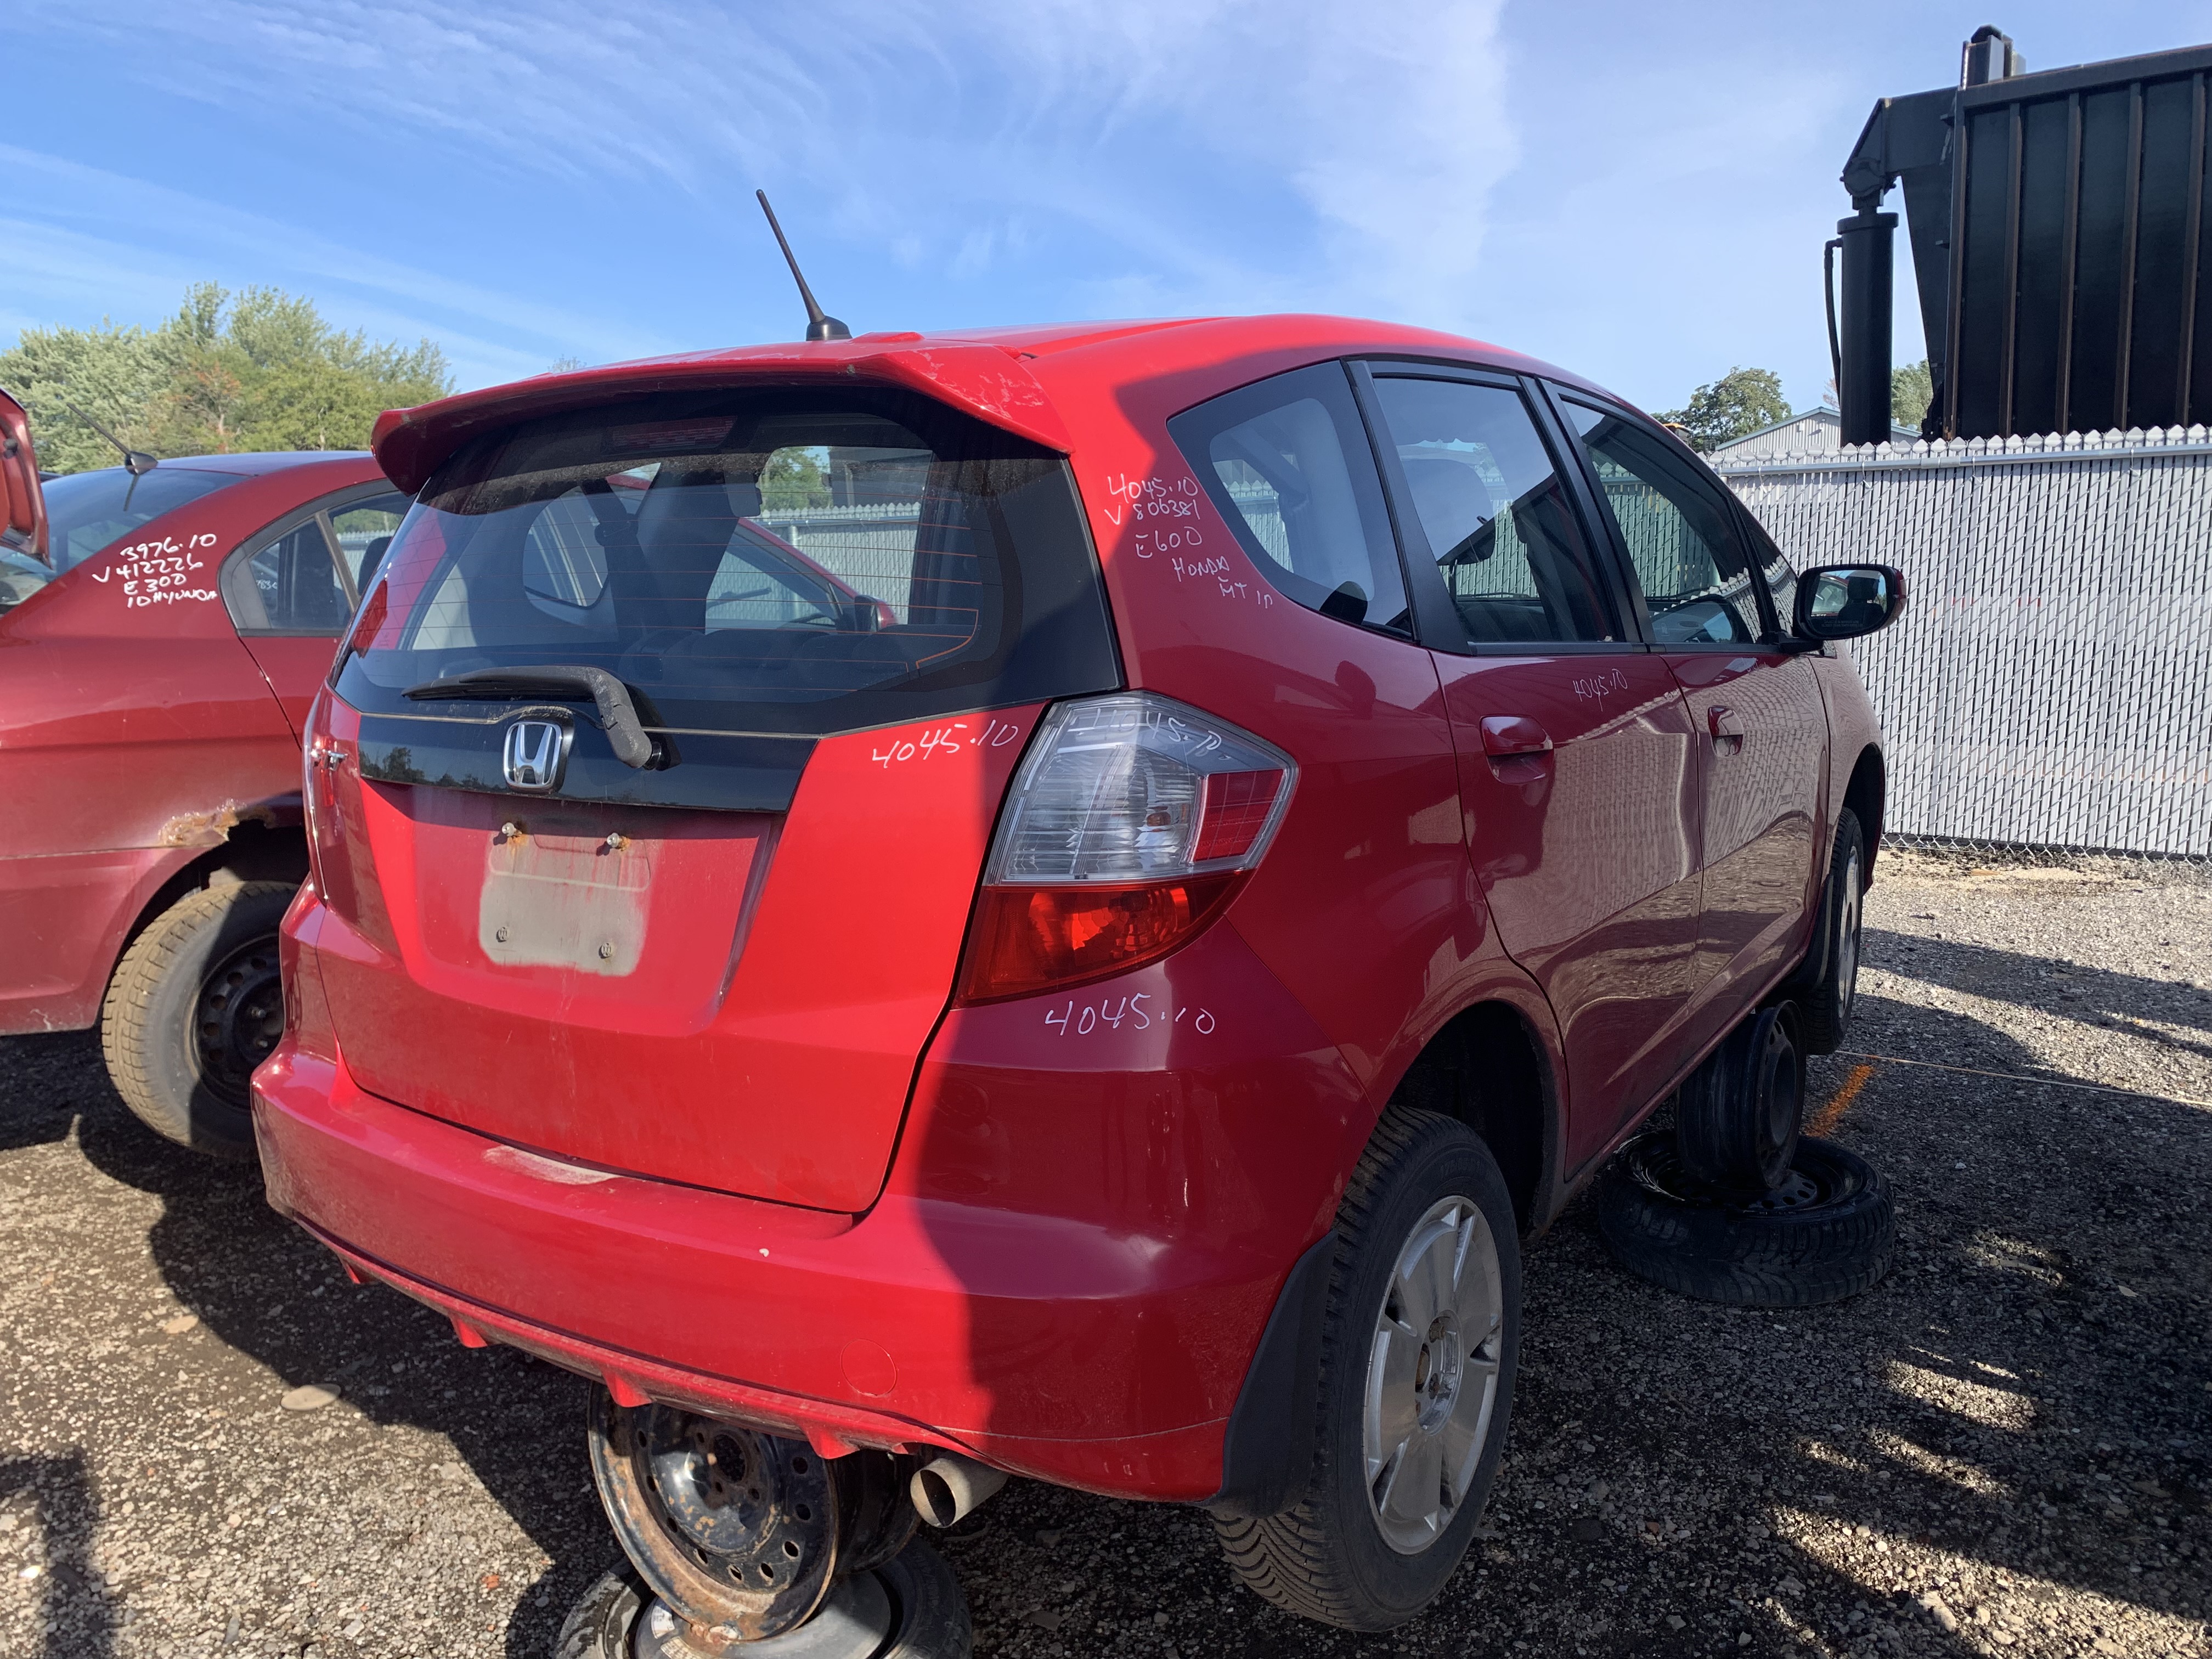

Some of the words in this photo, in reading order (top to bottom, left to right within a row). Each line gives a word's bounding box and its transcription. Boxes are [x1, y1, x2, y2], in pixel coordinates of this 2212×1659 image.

[1107, 473, 1198, 504] 4045.10
[1104, 505, 1121, 525] V
[120, 533, 217, 561] 3976.10
[92, 566, 110, 583] V
[1171, 555, 1230, 582] HONDA
[1572, 668, 1628, 712] 4045.10
[872, 719, 1018, 769] 4045.10
[1045, 992, 1215, 1036] 4045.10
